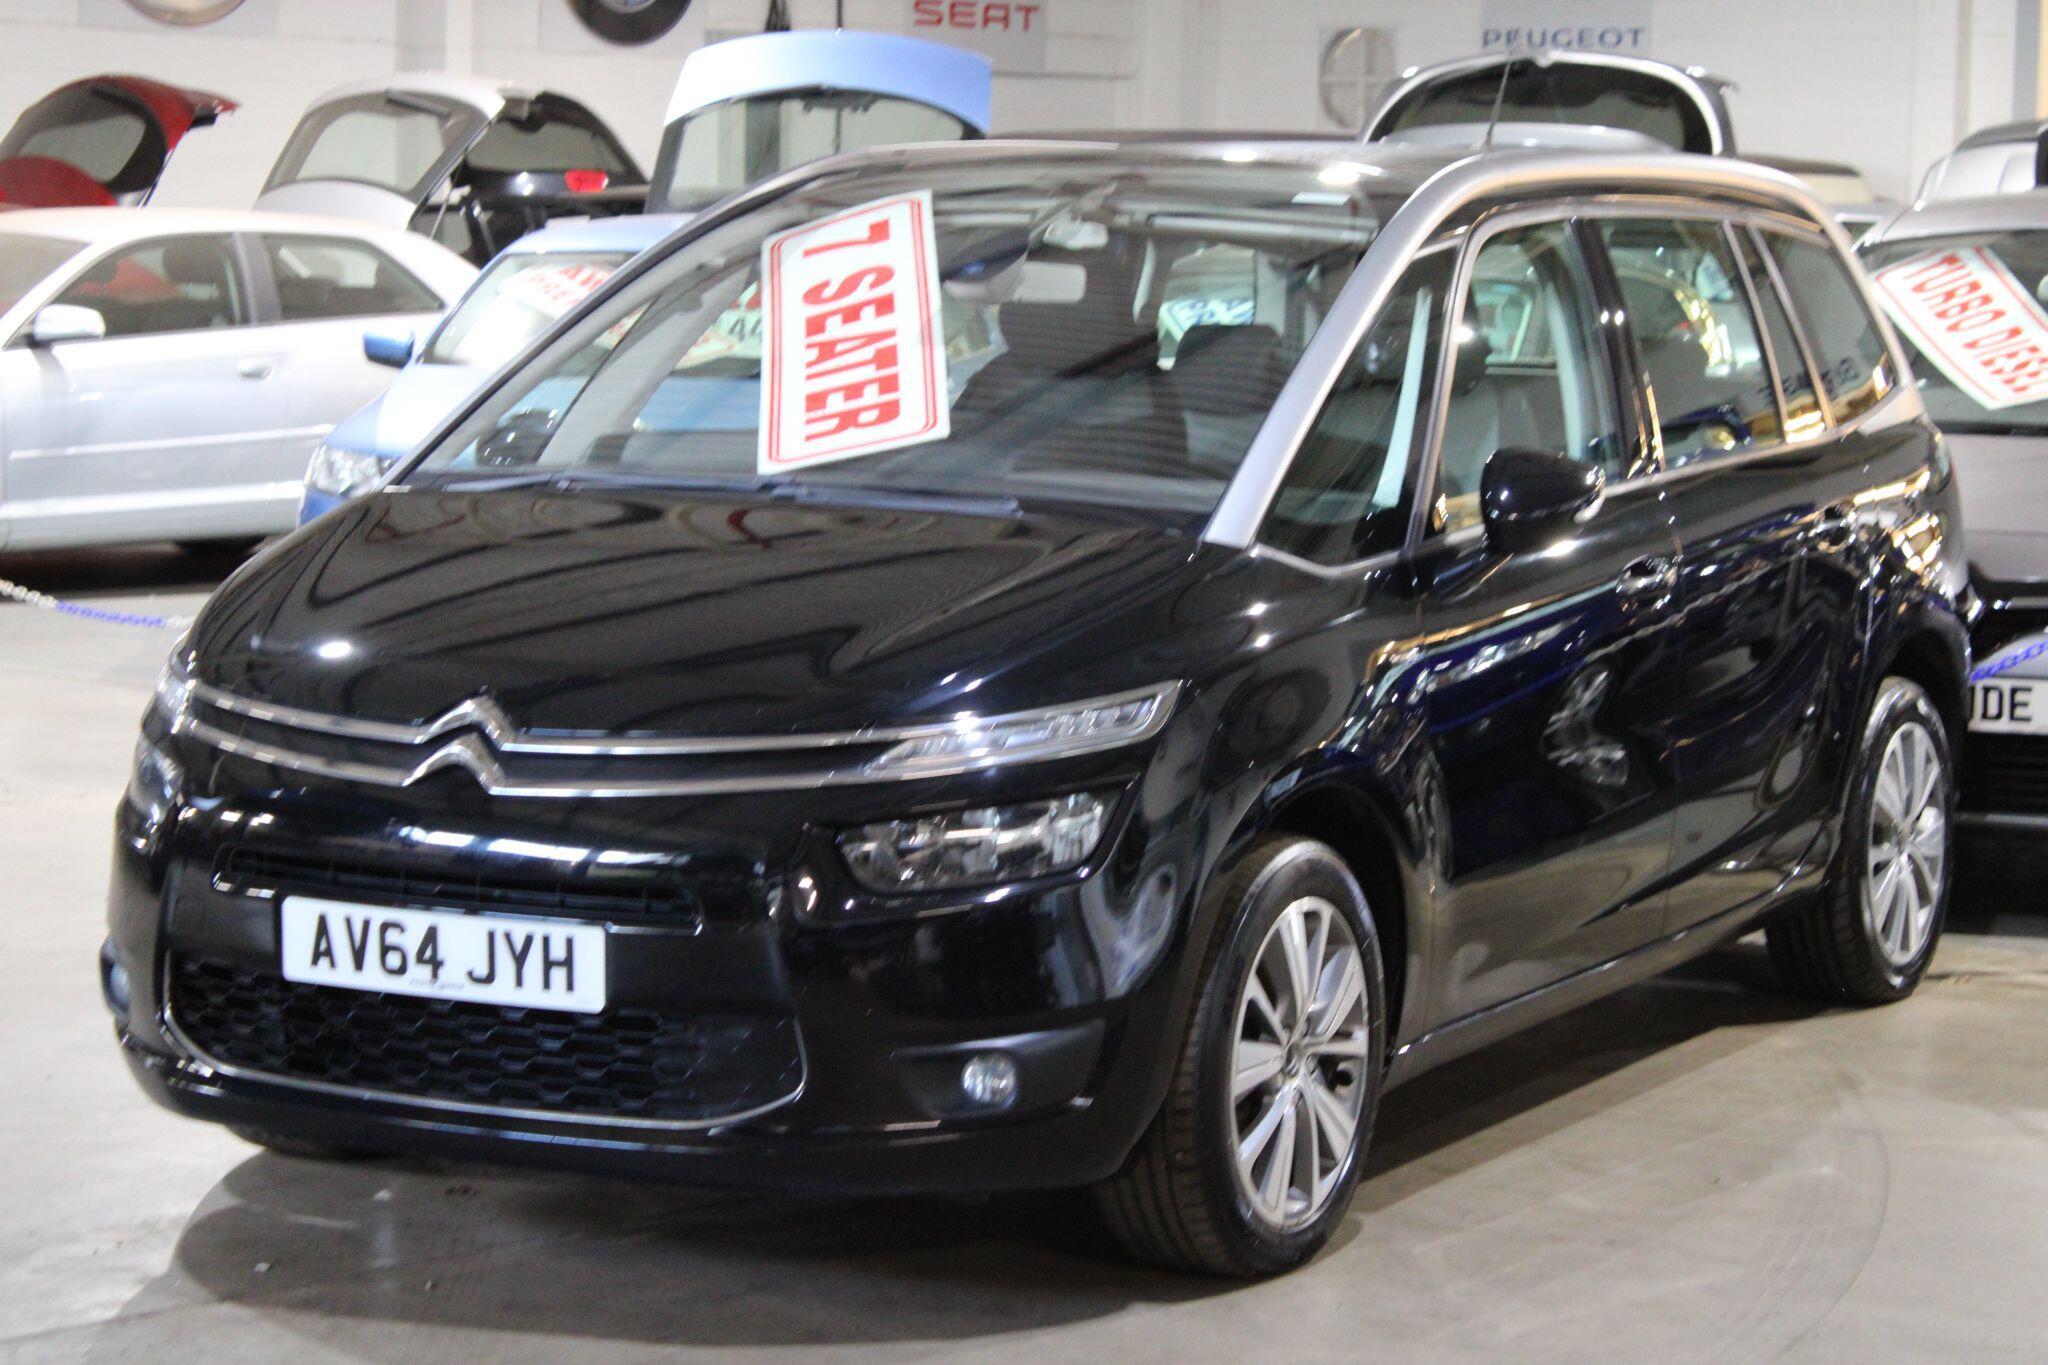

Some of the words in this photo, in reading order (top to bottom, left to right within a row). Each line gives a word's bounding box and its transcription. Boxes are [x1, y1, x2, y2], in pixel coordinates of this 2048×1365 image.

[914, 0, 1040, 31] SEAT
[1482, 27, 1646, 49] PEUGEOT
[803, 217, 890, 258] 7
[1903, 253, 2007, 332] TURBO
[802, 265, 900, 442] SEATER
[311, 912, 444, 980] AV64
[467, 929, 574, 992] JYH
